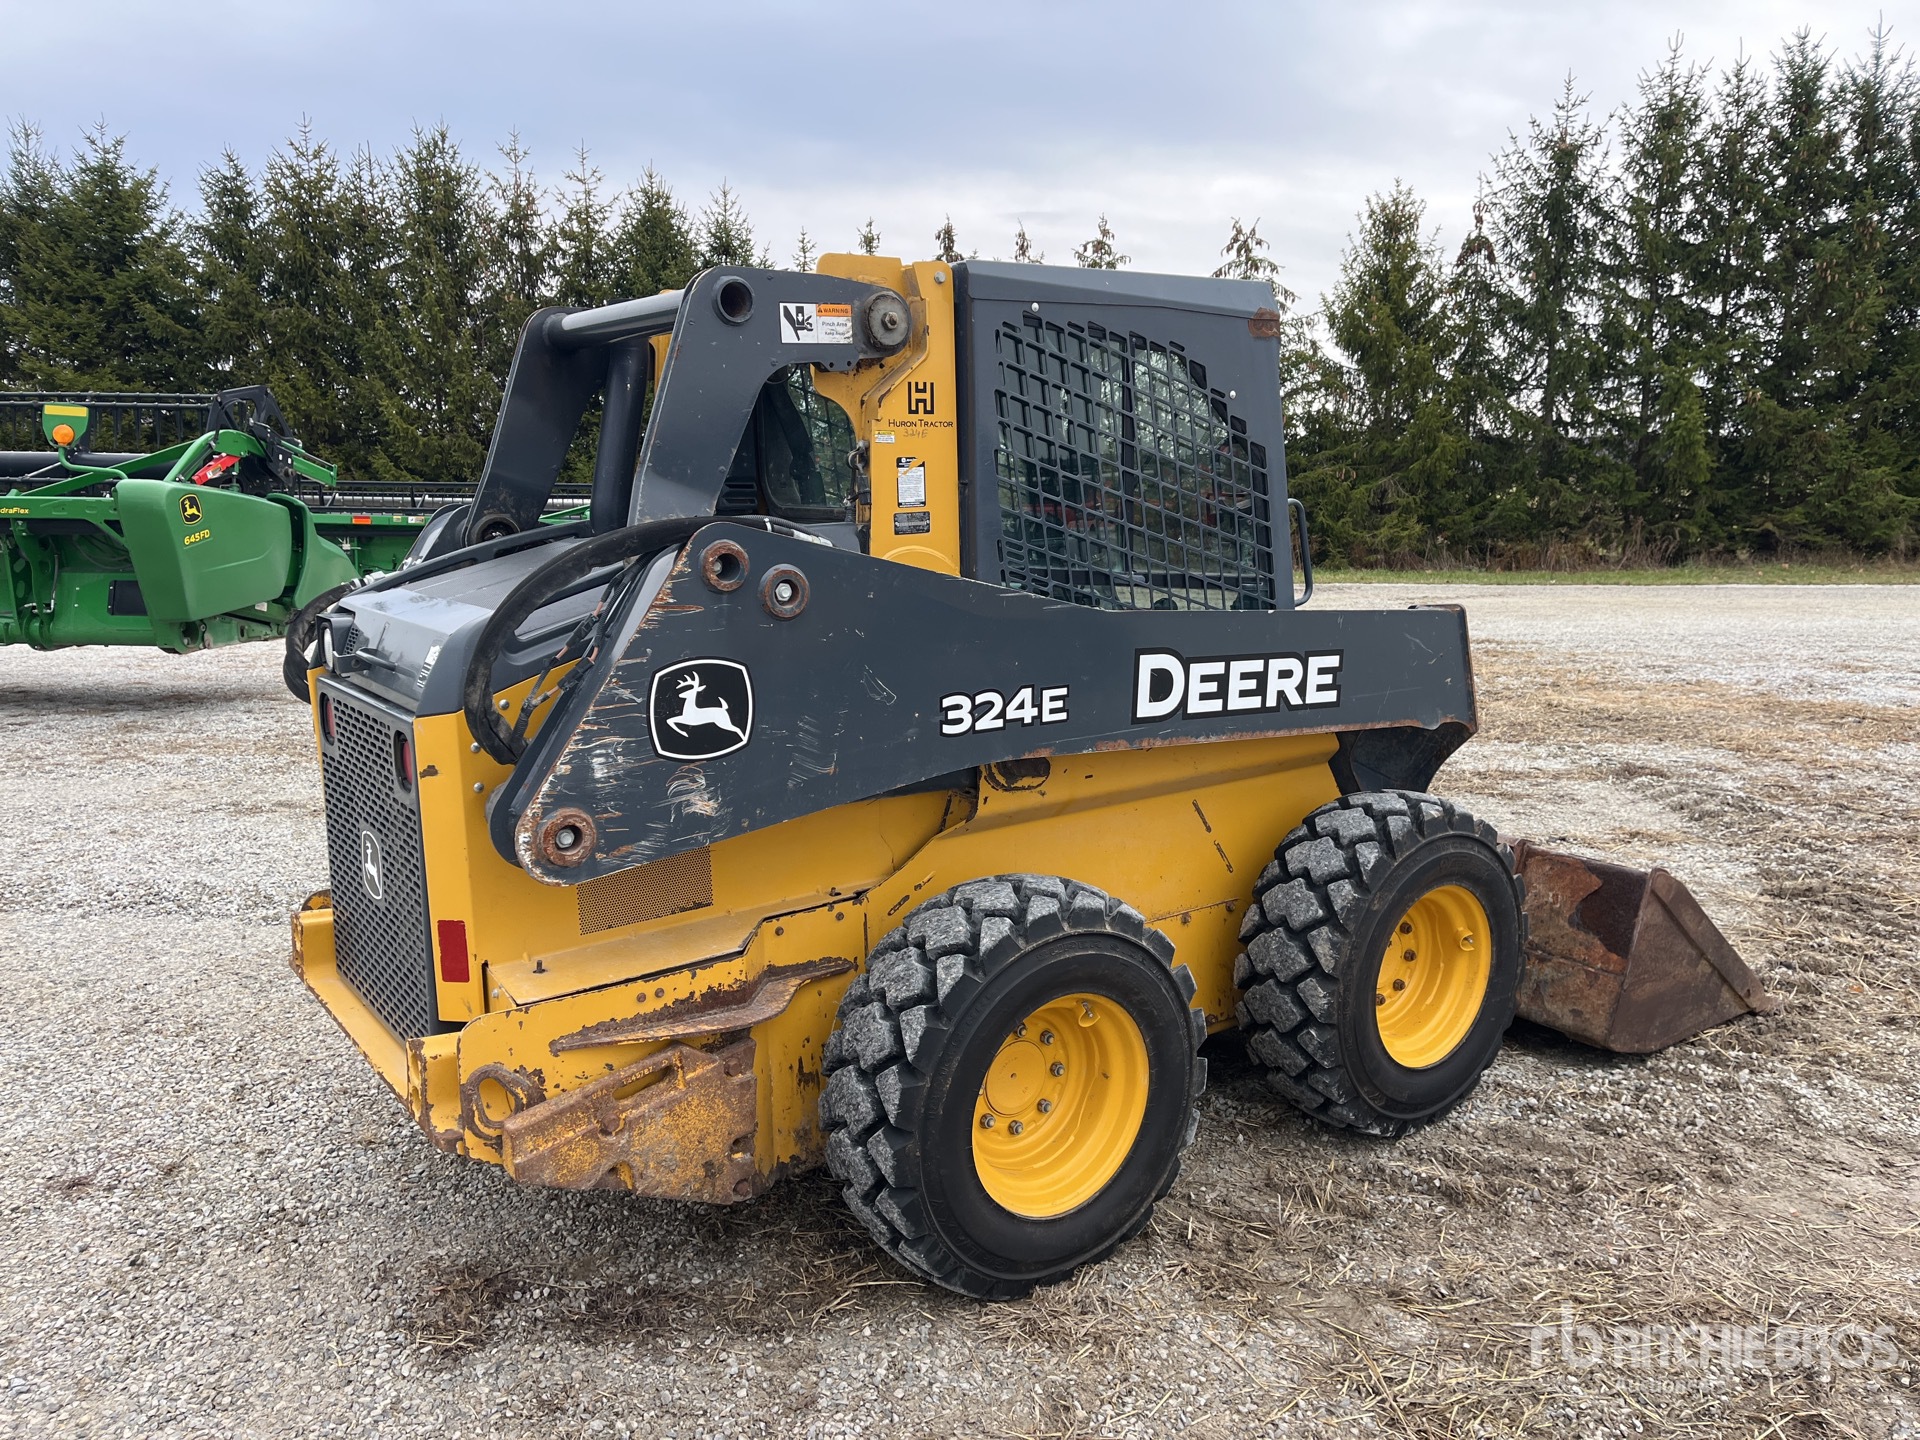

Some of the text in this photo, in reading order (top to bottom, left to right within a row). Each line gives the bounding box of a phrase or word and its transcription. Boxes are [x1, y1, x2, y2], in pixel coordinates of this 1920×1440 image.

[888, 418, 954, 428] HURON TRACTOR
[184, 529, 210, 545] 645FD
[1136, 652, 1341, 719] DEERE
[941, 686, 1069, 736] 324E
